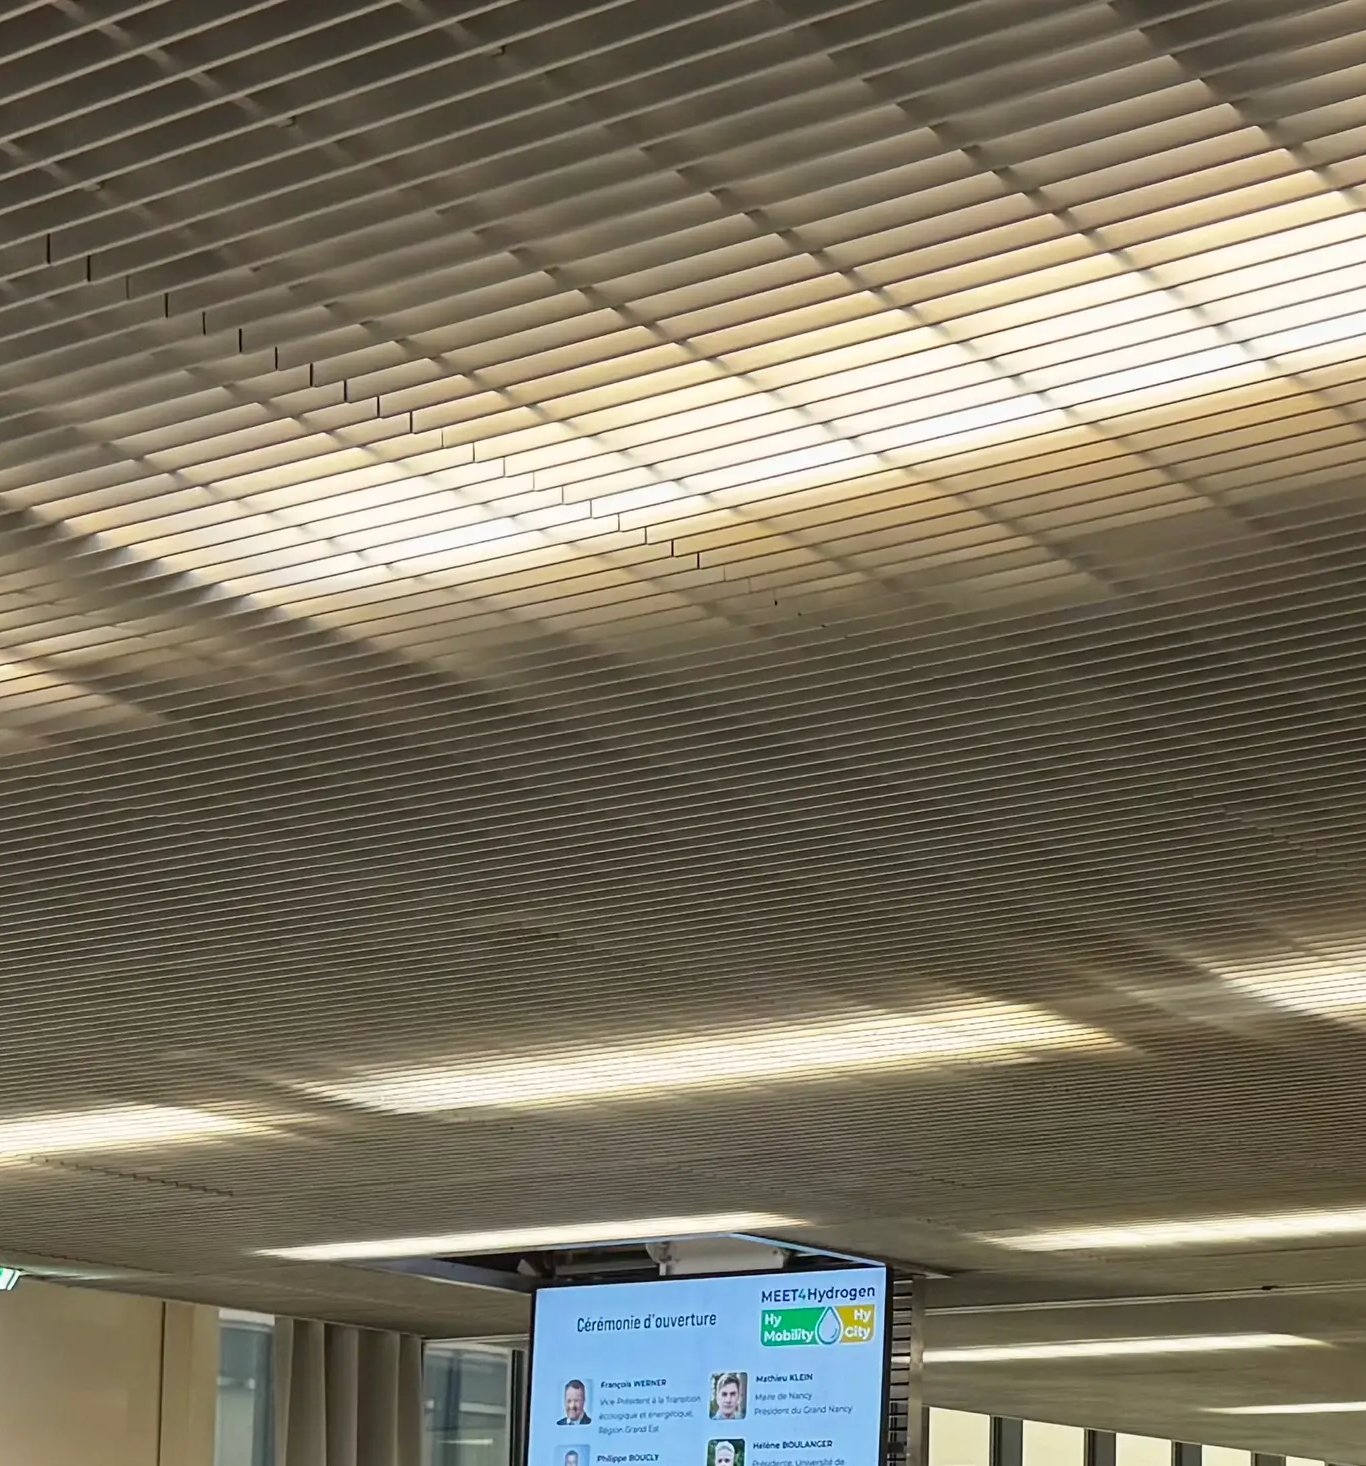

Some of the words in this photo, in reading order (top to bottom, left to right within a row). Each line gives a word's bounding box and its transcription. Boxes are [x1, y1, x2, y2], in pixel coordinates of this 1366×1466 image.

[761, 1286, 875, 1303] MEET4Hydrogen
[577, 1314, 641, 1332] Cérémonie
[643, 1312, 717, 1329] d'ouverture
[764, 1313, 782, 1328] Hy
[853, 1308, 871, 1322] Hy
[763, 1328, 814, 1343] Mobility
[844, 1325, 871, 1340] City
[633, 1379, 667, 1388] WERNER
[789, 1372, 813, 1381] KLEIN
[788, 1391, 813, 1401] Nancy
[782, 1440, 833, 1449] BOULANGER
